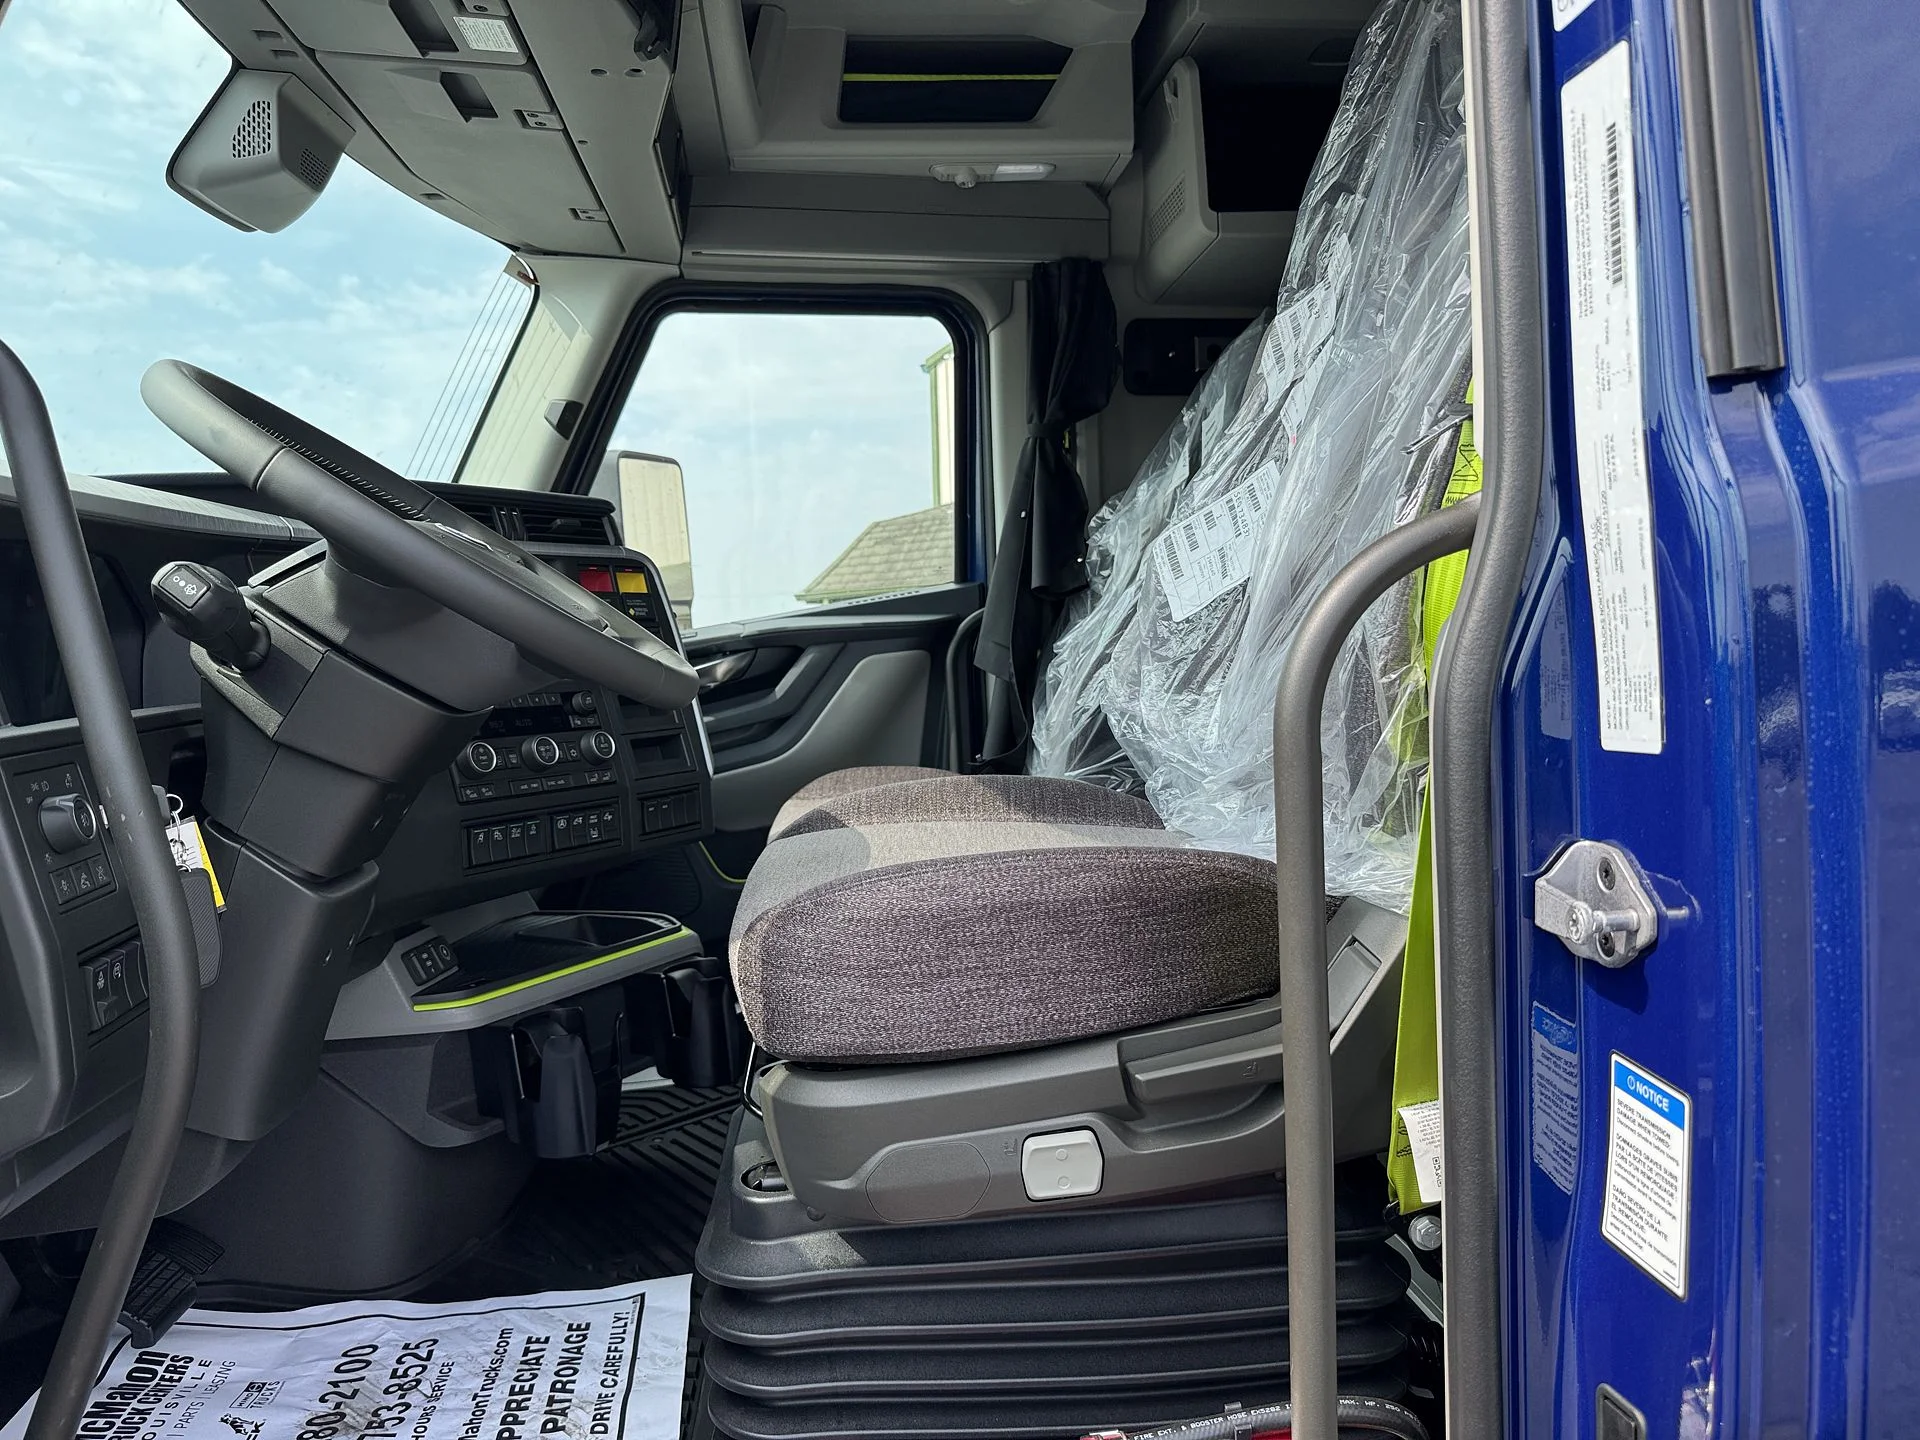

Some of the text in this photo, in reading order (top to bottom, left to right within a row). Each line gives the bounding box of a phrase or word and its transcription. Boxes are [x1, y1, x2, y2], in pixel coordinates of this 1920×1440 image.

[1636, 1081, 1669, 1111] NOTICE
[137, 1354, 195, 1406] CENTERS
[173, 1360, 236, 1429] PARTS LEASING
[250, 1380, 281, 1409] TRUCKS
[427, 1361, 455, 1404] SERVICE
[540, 1321, 592, 1434] PATRONAGE
[590, 1311, 631, 1434] DRIVE CAREFULLY!
[1134, 1432, 1155, 1440] FIRE
[1157, 1428, 1177, 1437] EXT.
[1190, 1416, 1224, 1429] BOOSTER
[1227, 1411, 1248, 1421] HOSE
